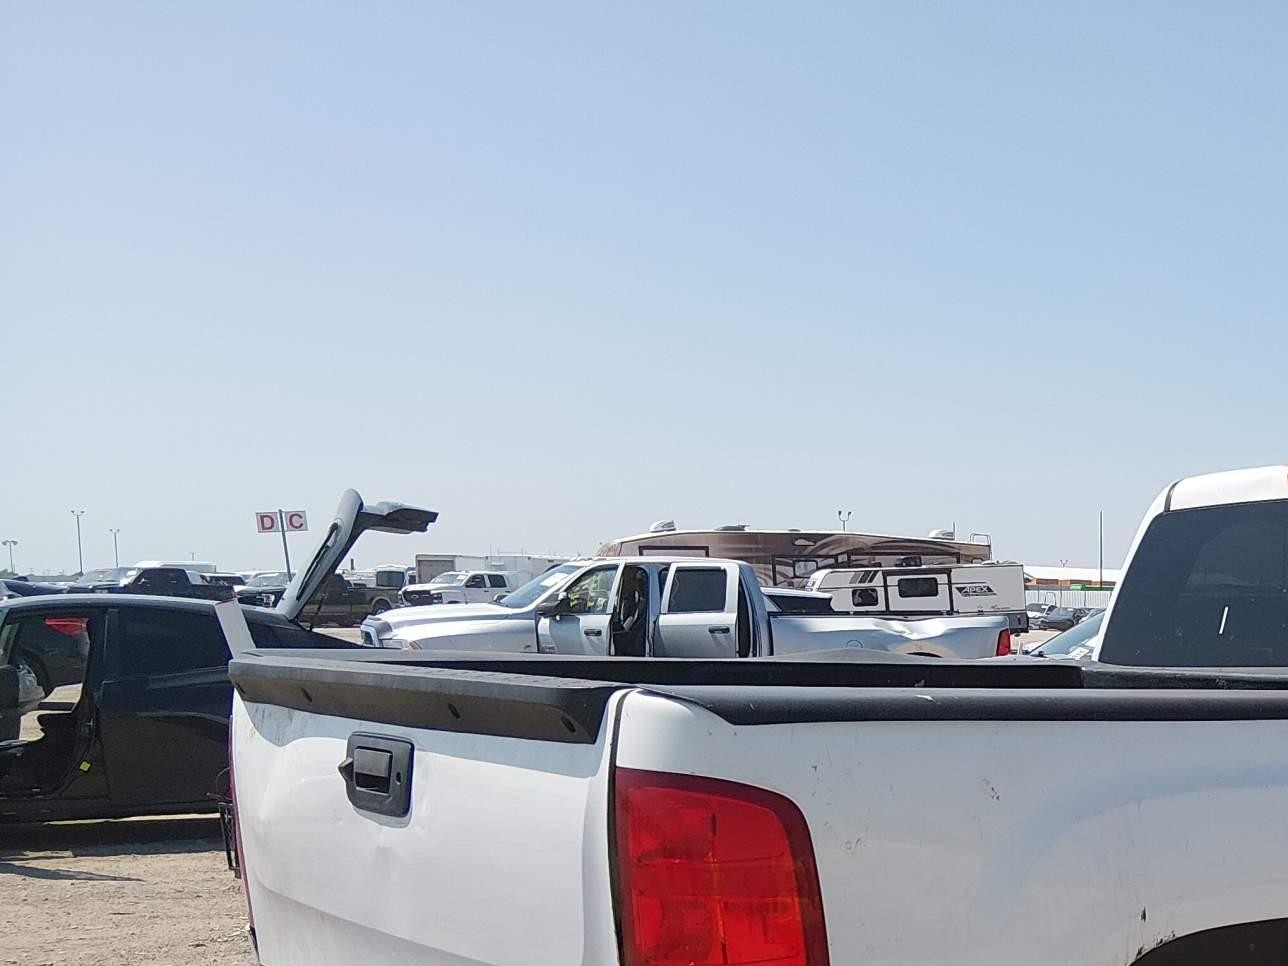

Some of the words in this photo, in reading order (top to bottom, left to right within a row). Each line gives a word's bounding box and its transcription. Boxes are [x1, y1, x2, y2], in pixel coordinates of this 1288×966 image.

[259, 514, 275, 531] D
[289, 512, 304, 529] C
[961, 585, 989, 593] APEX
